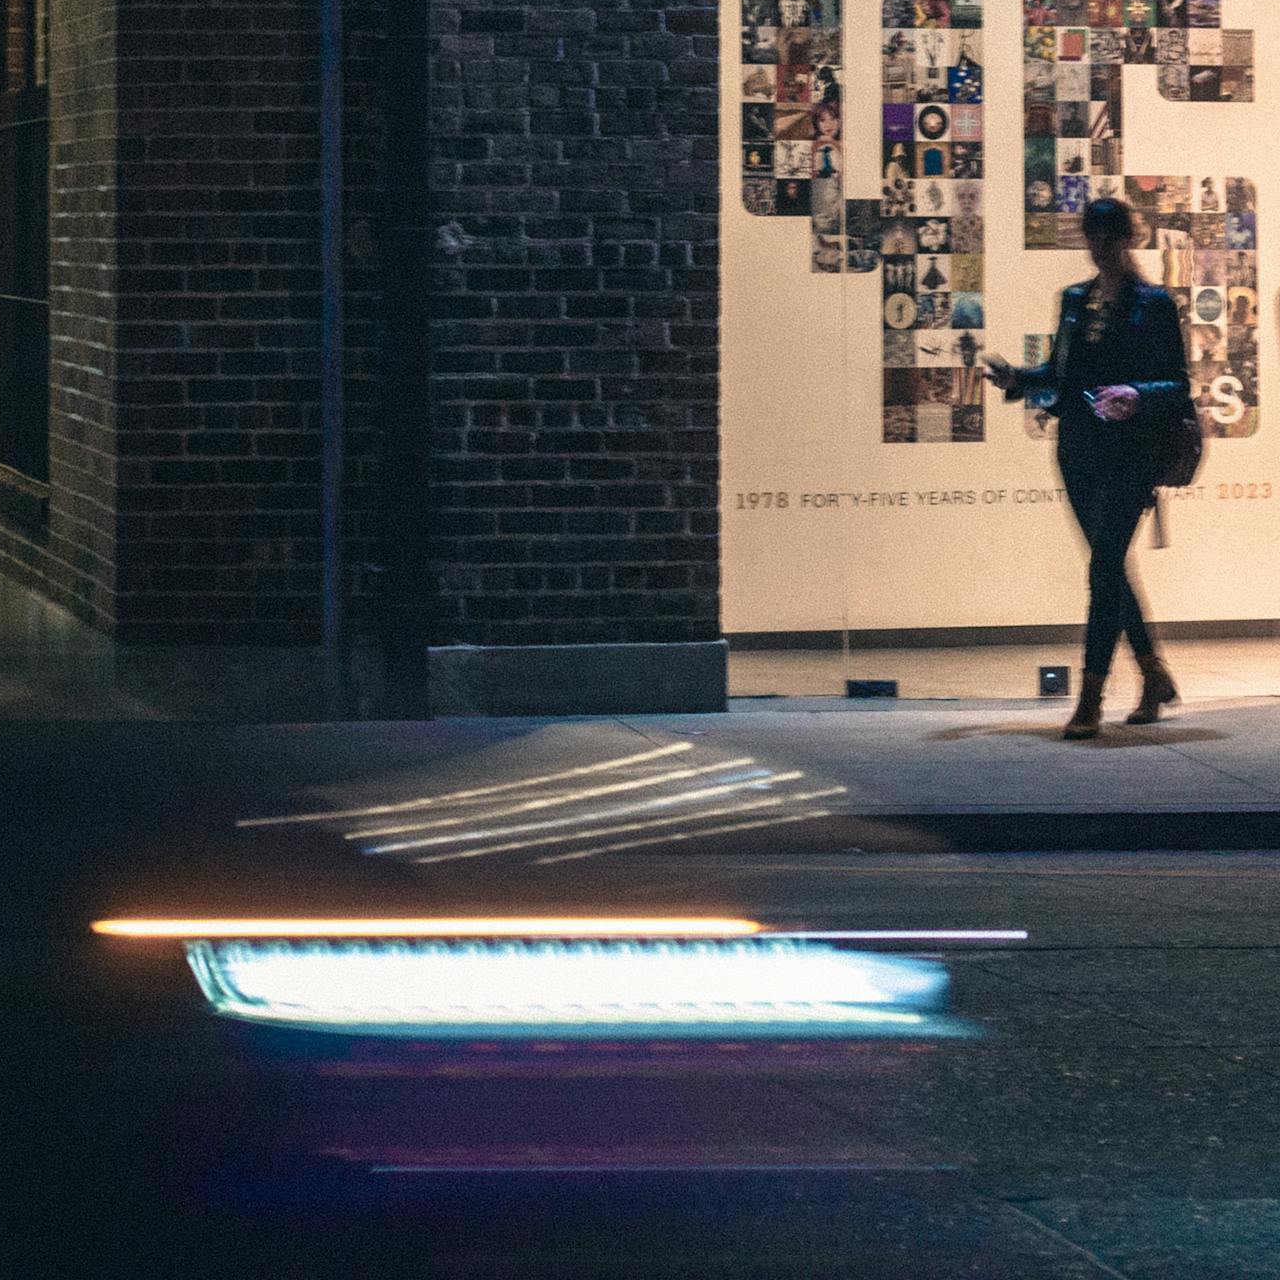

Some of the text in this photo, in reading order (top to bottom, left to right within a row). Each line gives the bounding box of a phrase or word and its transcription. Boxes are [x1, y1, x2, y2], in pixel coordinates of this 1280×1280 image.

[736, 491, 789, 510] 1978
[917, 489, 977, 506] YEARS
[981, 489, 1008, 505] OF
[1218, 482, 1273, 499] 2023
